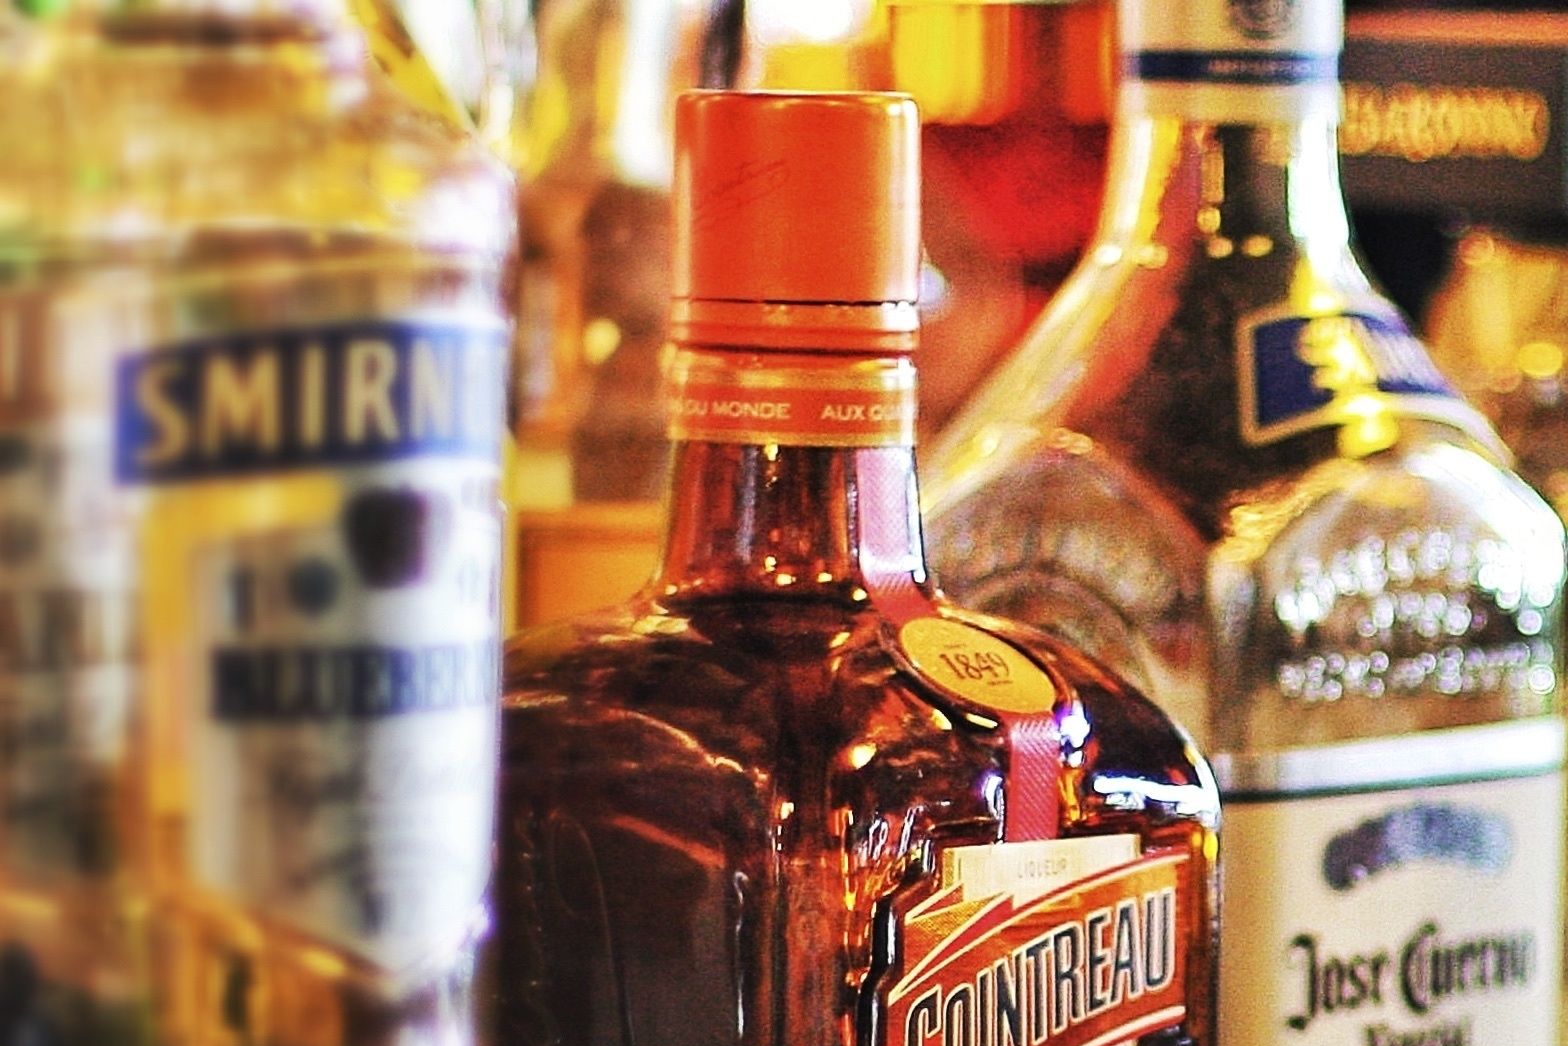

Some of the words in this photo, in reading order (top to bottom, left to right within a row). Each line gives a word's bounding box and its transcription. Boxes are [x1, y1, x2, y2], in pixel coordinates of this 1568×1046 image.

[711, 401, 791, 420] MONDE
[820, 404, 865, 422] AUX
[939, 651, 1010, 680] 1849
